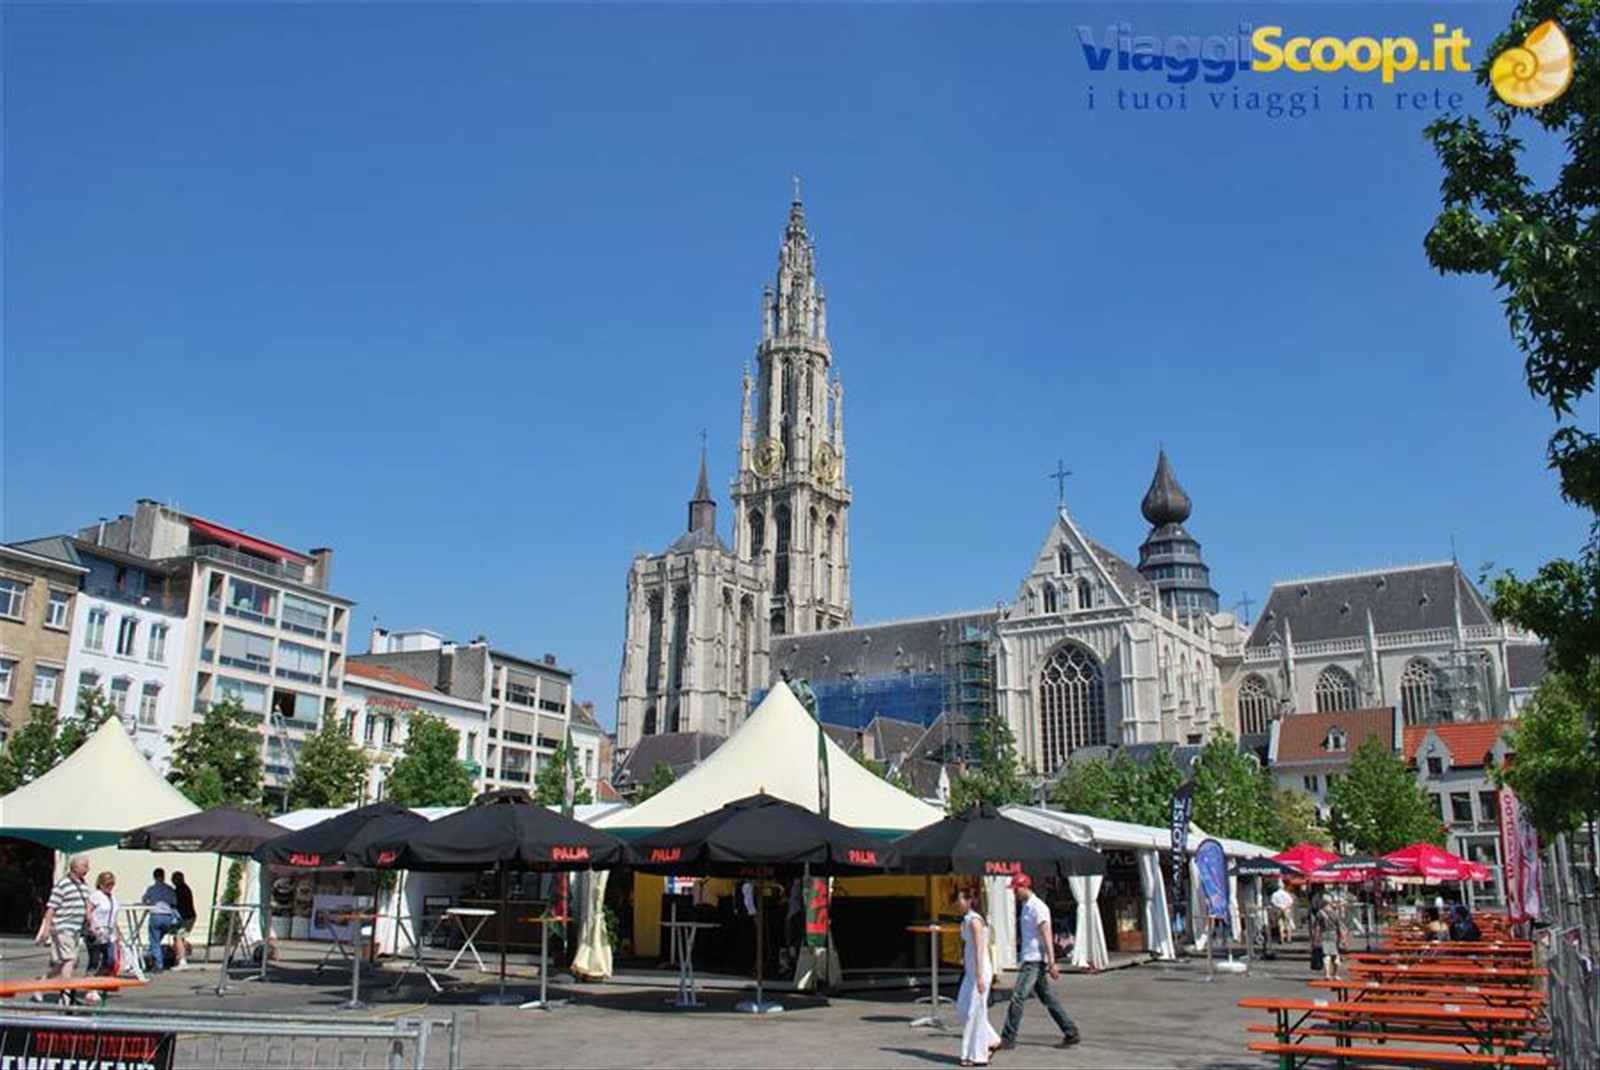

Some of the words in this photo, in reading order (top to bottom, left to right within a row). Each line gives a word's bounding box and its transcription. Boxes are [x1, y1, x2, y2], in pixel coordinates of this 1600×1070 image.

[552, 847, 588, 861] PALM
[651, 848, 682, 861] PALM
[848, 851, 876, 865] PALM
[985, 861, 1022, 874] PALM
